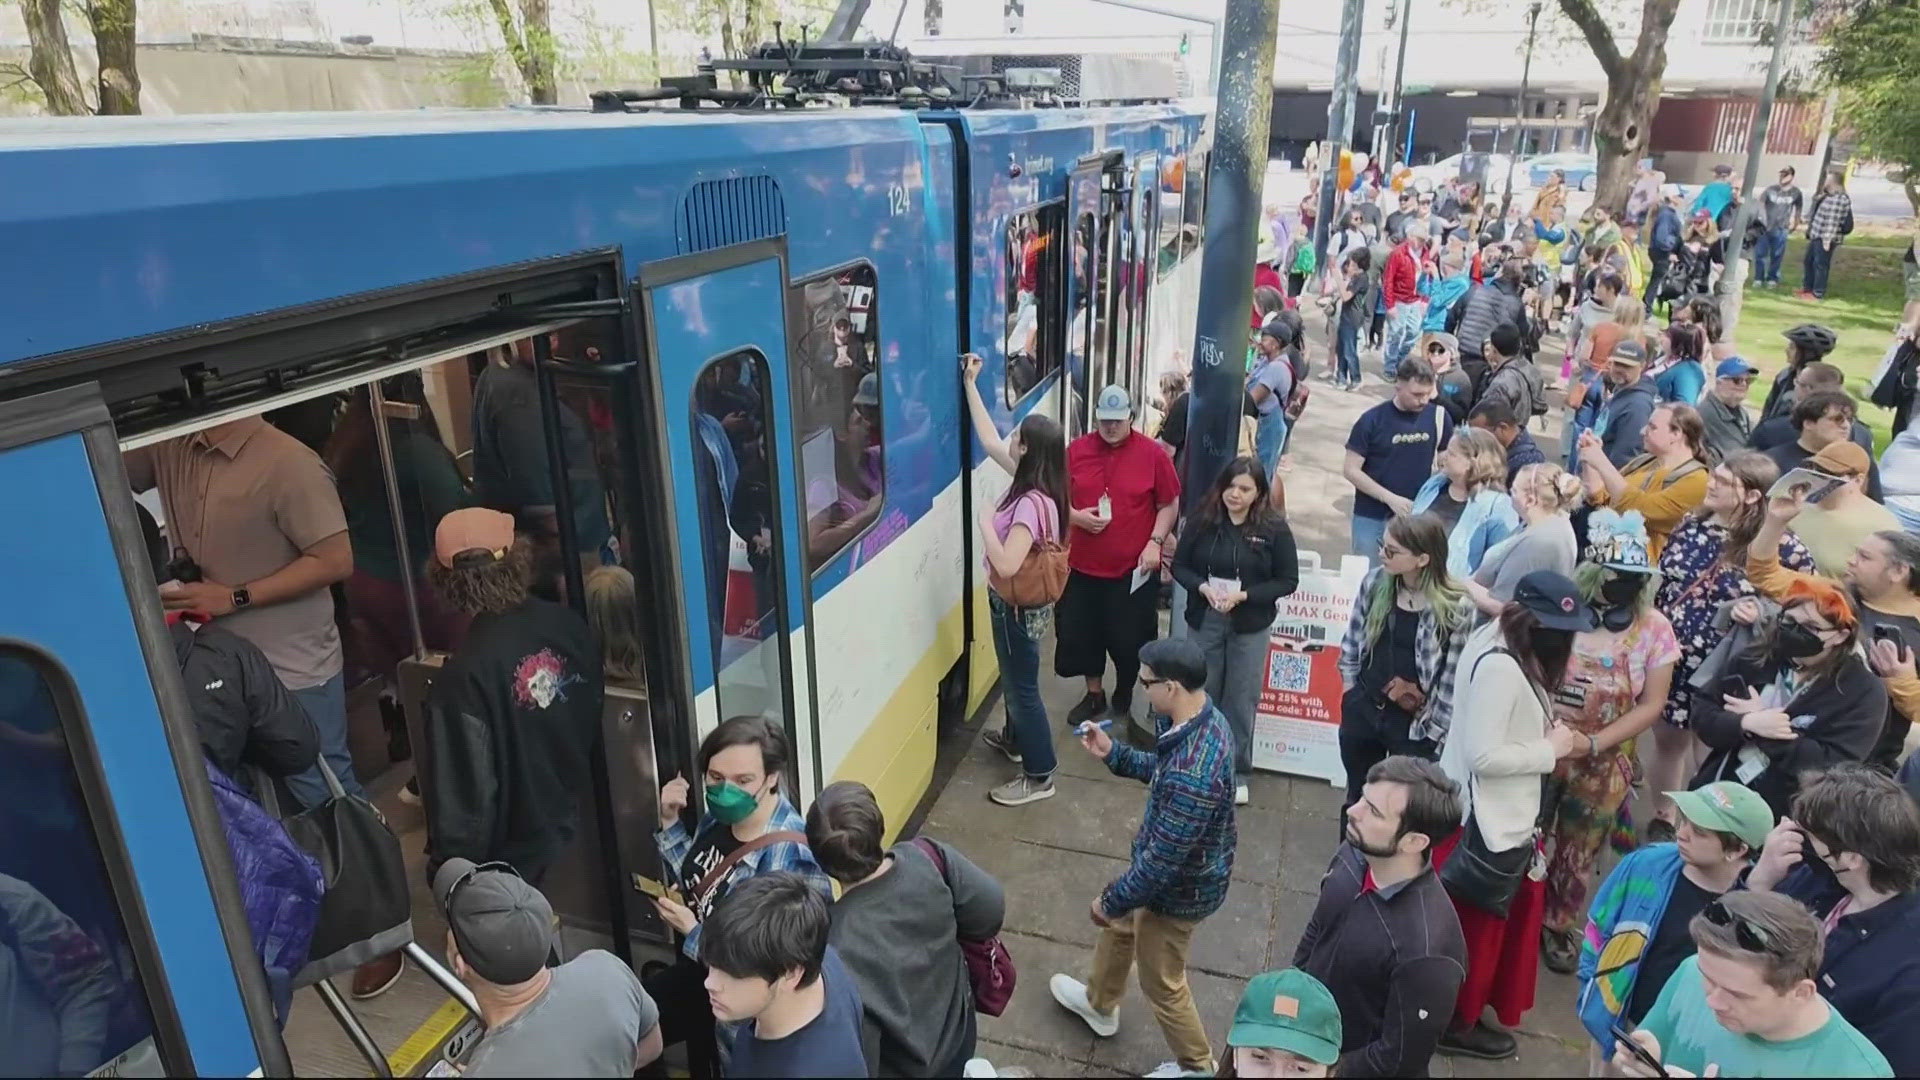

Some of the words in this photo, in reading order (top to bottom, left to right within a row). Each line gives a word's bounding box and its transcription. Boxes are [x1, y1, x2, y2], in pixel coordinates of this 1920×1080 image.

[888, 184, 910, 217] 124
[1284, 590, 1328, 603] nline
[1286, 604, 1319, 618] MAX
[1323, 608, 1349, 621] Gea
[1278, 692, 1298, 704] 25%
[1301, 697, 1323, 708] with
[1276, 705, 1303, 715] code:
